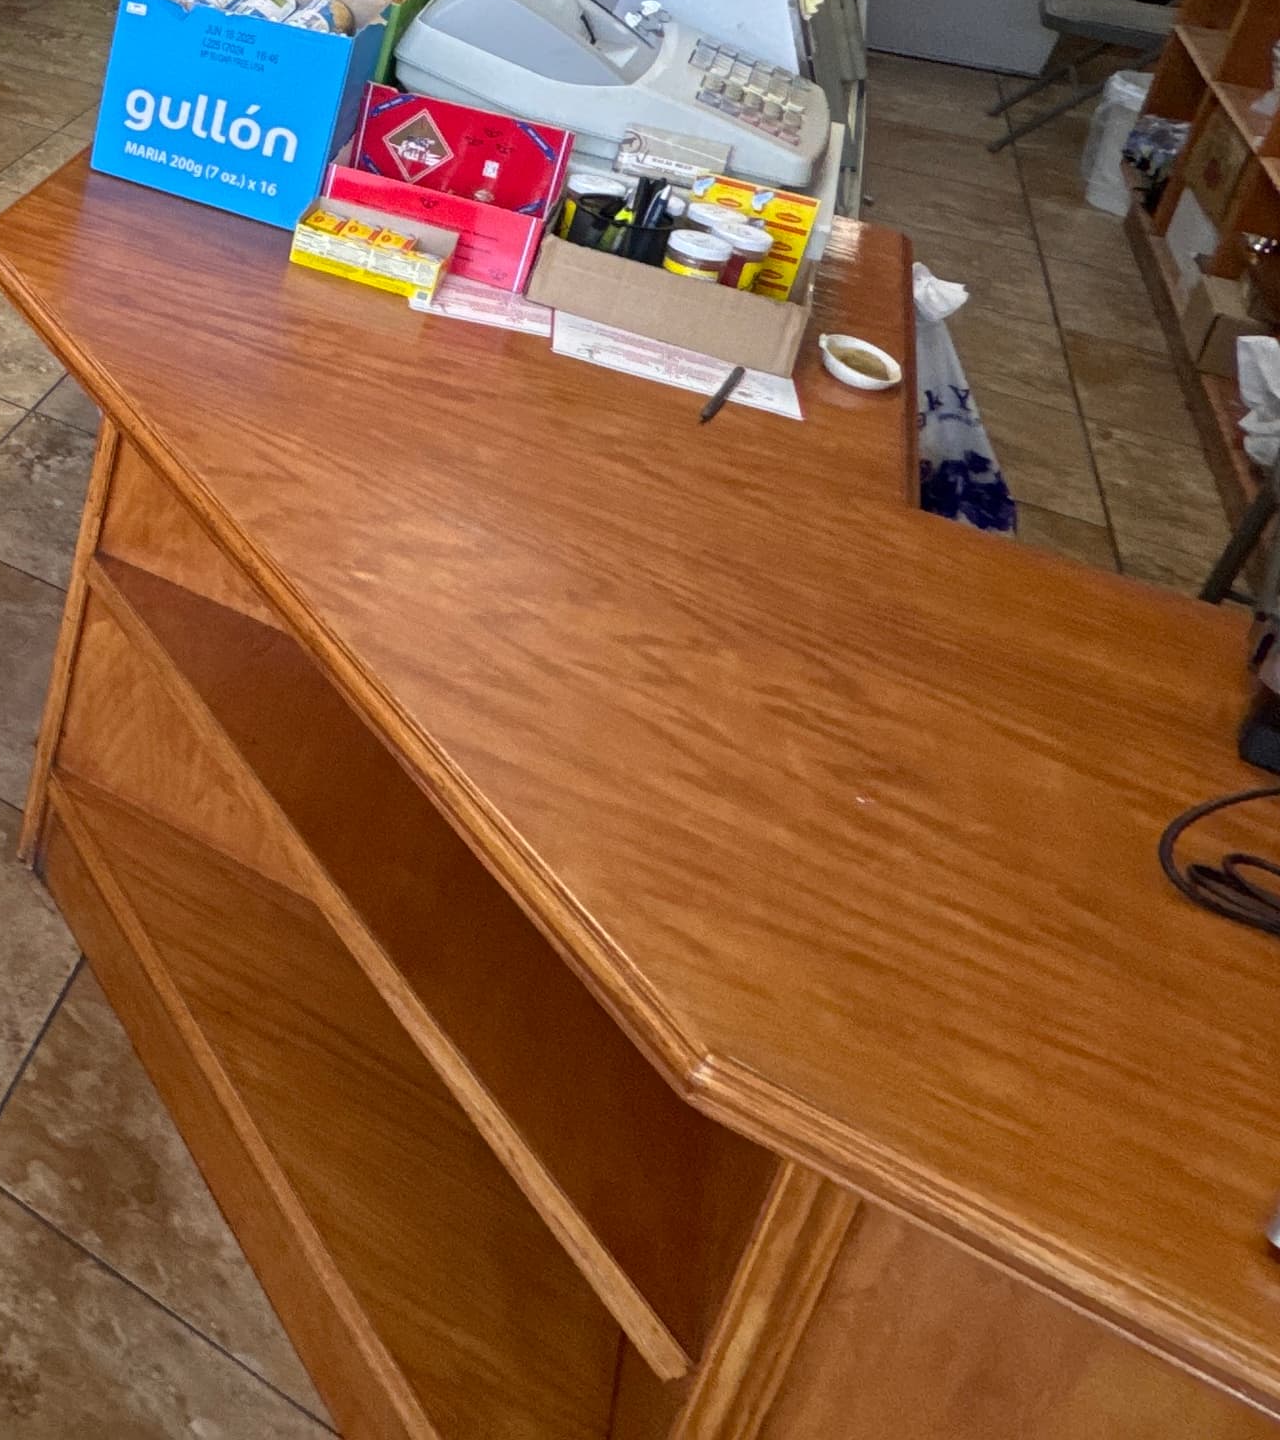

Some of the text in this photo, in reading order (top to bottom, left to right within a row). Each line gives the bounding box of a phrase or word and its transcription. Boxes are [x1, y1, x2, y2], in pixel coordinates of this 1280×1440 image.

[123, 88, 299, 164] gullón
[125, 139, 278, 197] MARIA 200g (7 oz.) x 16
